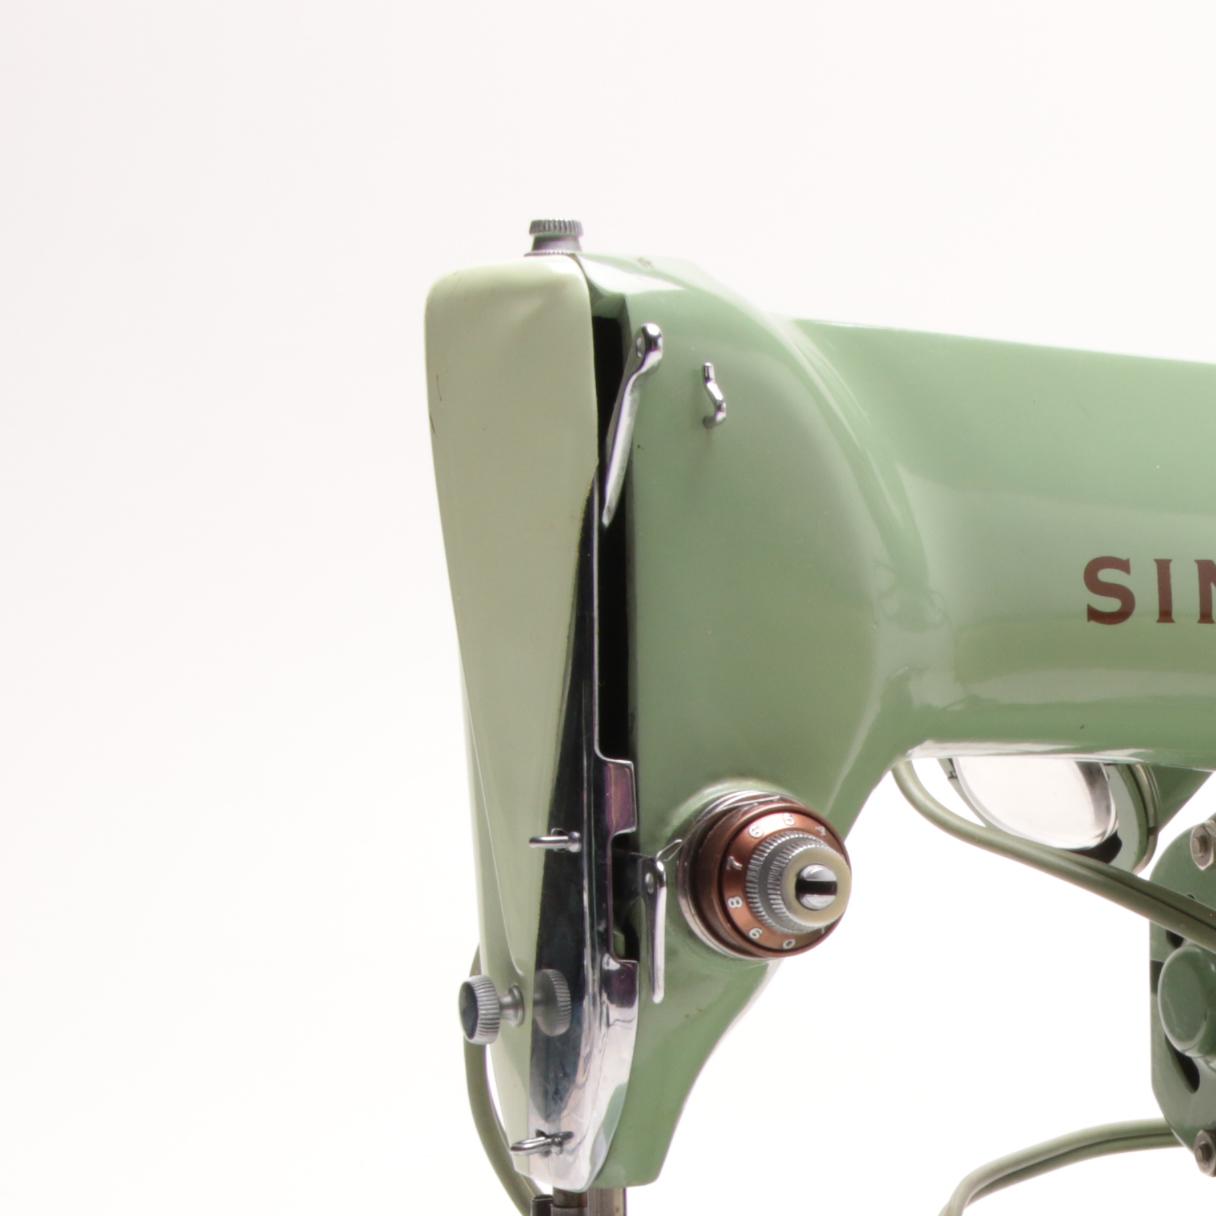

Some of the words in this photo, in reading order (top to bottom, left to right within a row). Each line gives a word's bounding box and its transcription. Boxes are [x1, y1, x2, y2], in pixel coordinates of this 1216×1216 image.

[726, 855, 743, 871] 7
[727, 896, 743, 909] 8
[782, 938, 796, 950] 0
